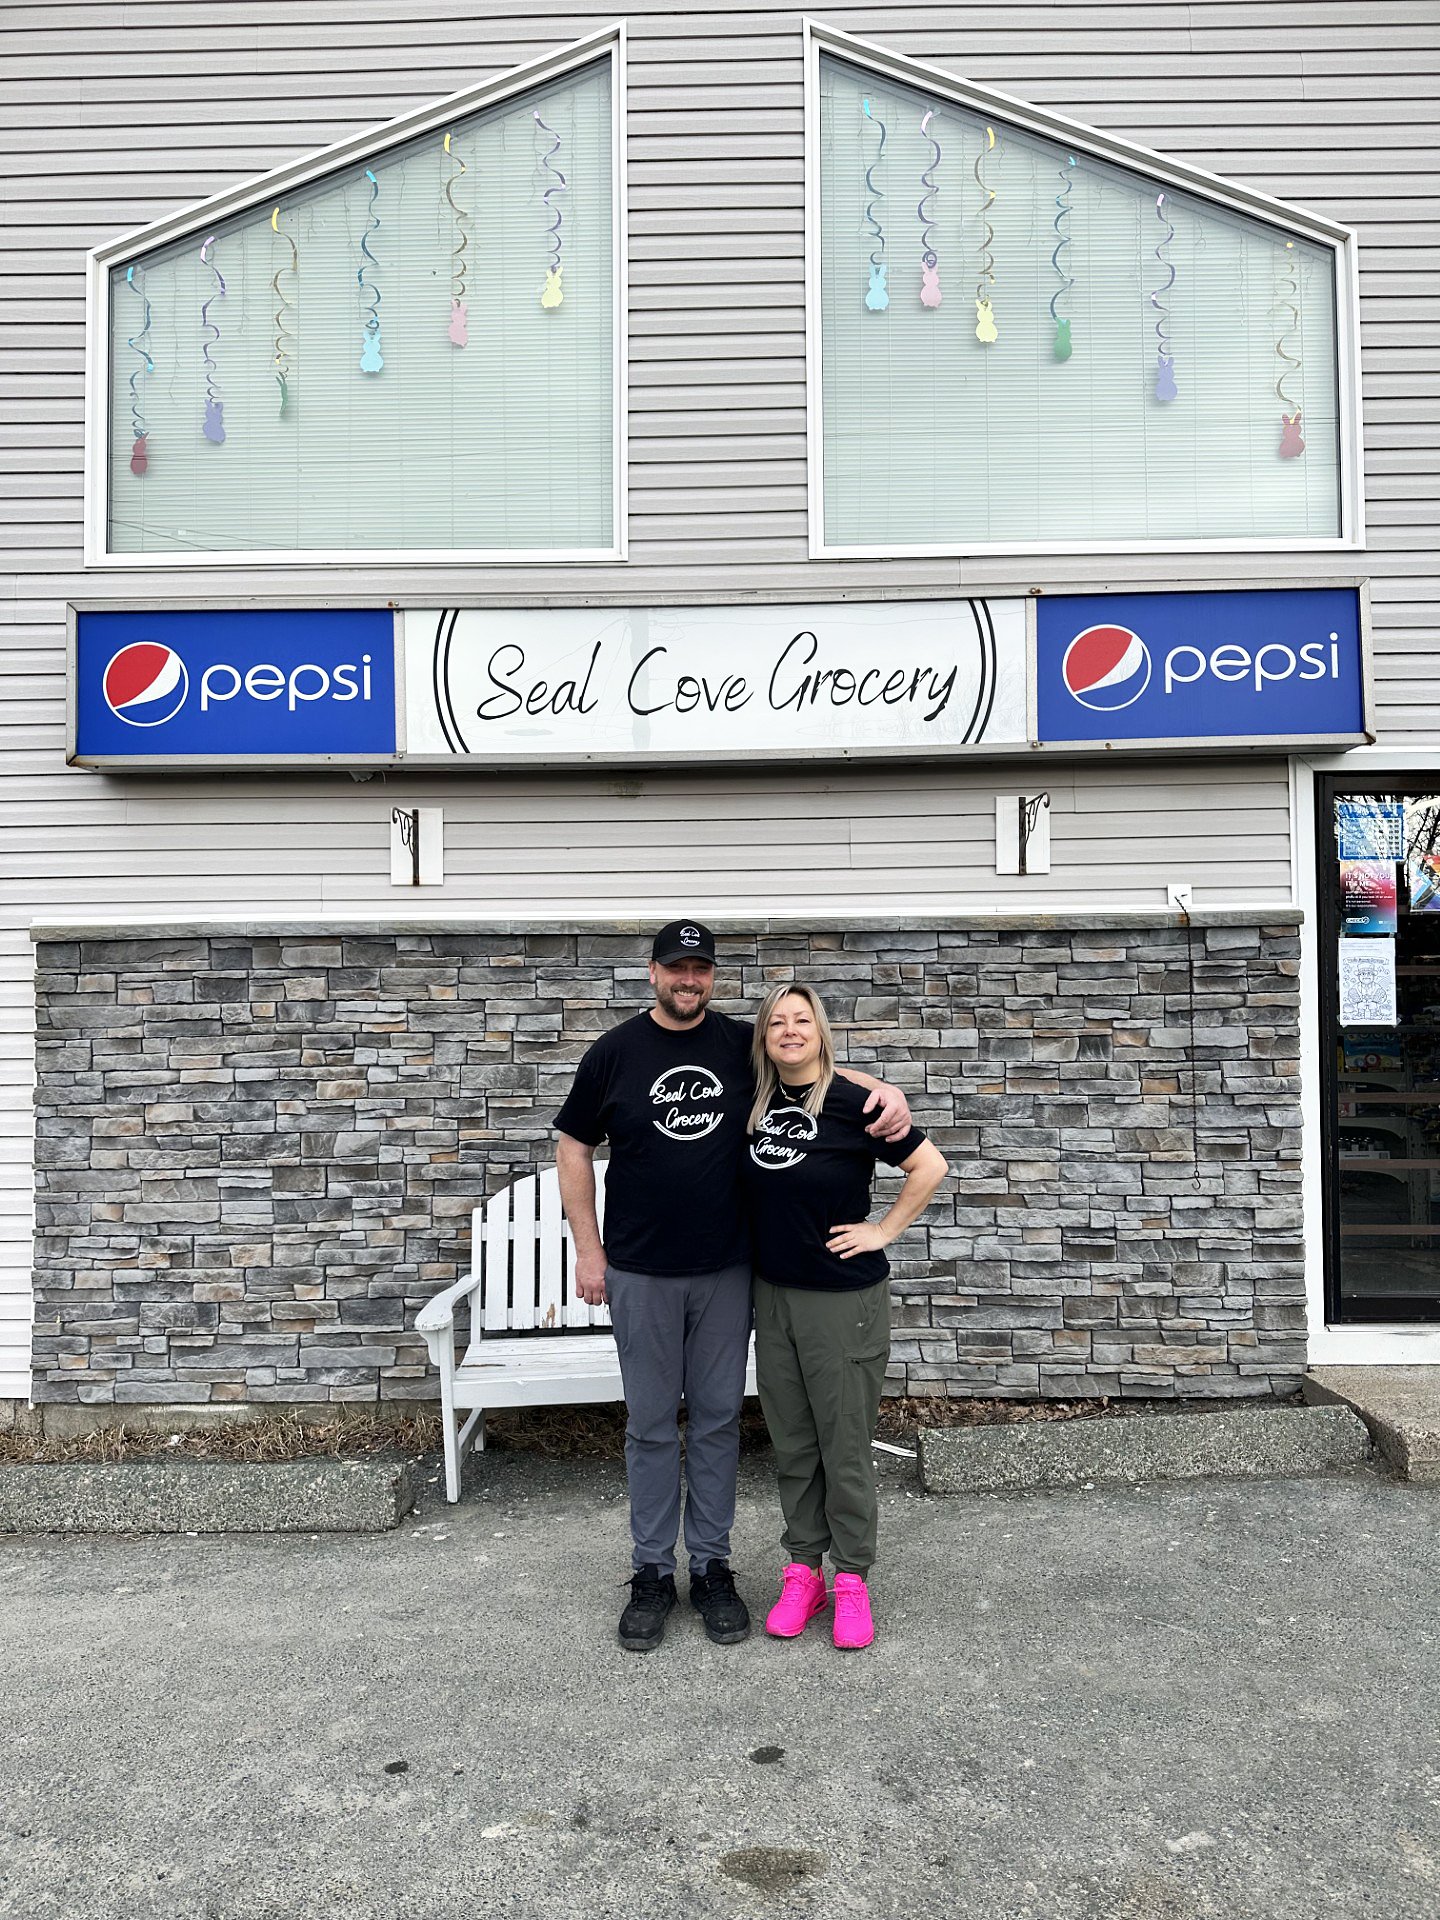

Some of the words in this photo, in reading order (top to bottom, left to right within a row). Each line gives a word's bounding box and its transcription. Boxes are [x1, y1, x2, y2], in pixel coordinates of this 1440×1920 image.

[1164, 632, 1340, 694] pepsi
[200, 655, 372, 711] pepsi
[477, 641, 602, 720] Seal
[627, 646, 754, 716] Cove
[768, 631, 958, 721] Grocery
[652, 1081, 686, 1105] Seal
[690, 1081, 724, 1100] Cove
[665, 1107, 715, 1129] Grocery
[760, 1117, 790, 1136] Seal
[787, 1123, 817, 1141] Cove
[755, 1136, 797, 1161] Grocery
